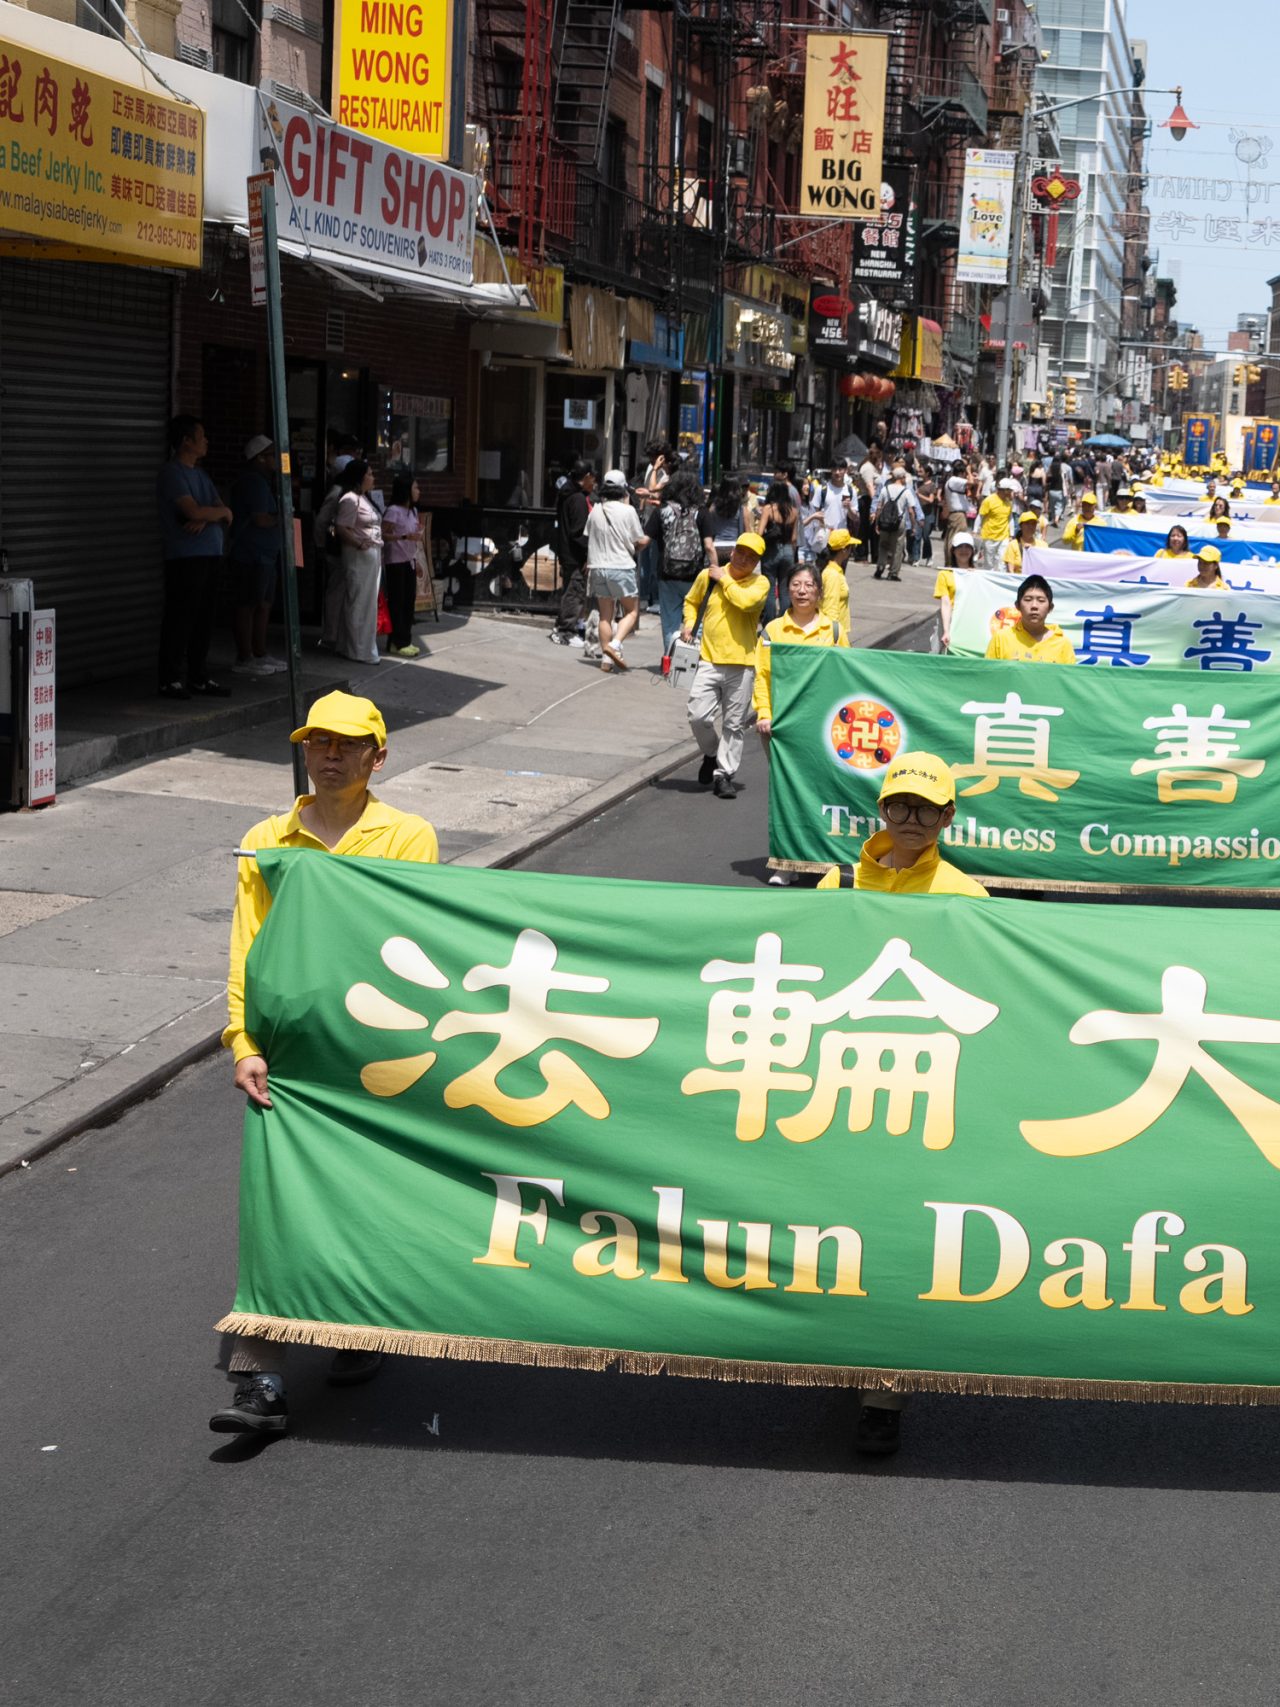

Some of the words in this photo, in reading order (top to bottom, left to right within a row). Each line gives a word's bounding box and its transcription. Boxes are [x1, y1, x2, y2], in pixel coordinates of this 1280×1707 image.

[360, 1, 423, 38] MING
[351, 48, 429, 86] WONG
[826, 39, 863, 123] 大旺
[339, 94, 442, 133] RESTAURANT
[814, 127, 873, 154] 飯店
[11, 140, 42, 177] Beef
[45, 151, 81, 195] Jerky
[84, 160, 106, 194] Inc.
[283, 115, 373, 215] GIFT
[381, 152, 466, 242] SHOP
[821, 158, 862, 182] BIG
[807, 184, 875, 211] WONG
[973, 210, 1003, 223] Love
[137, 221, 198, 251] 212-965-0796
[288, 205, 311, 232] ALL
[314, 211, 340, 236] KIND
[343, 221, 358, 243] OF
[359, 225, 416, 261] SOUVENIRS
[821, 803, 1057, 854] Truulness
[472, 1172, 868, 1298] Falun
[917, 1200, 1254, 1316] Dafa
